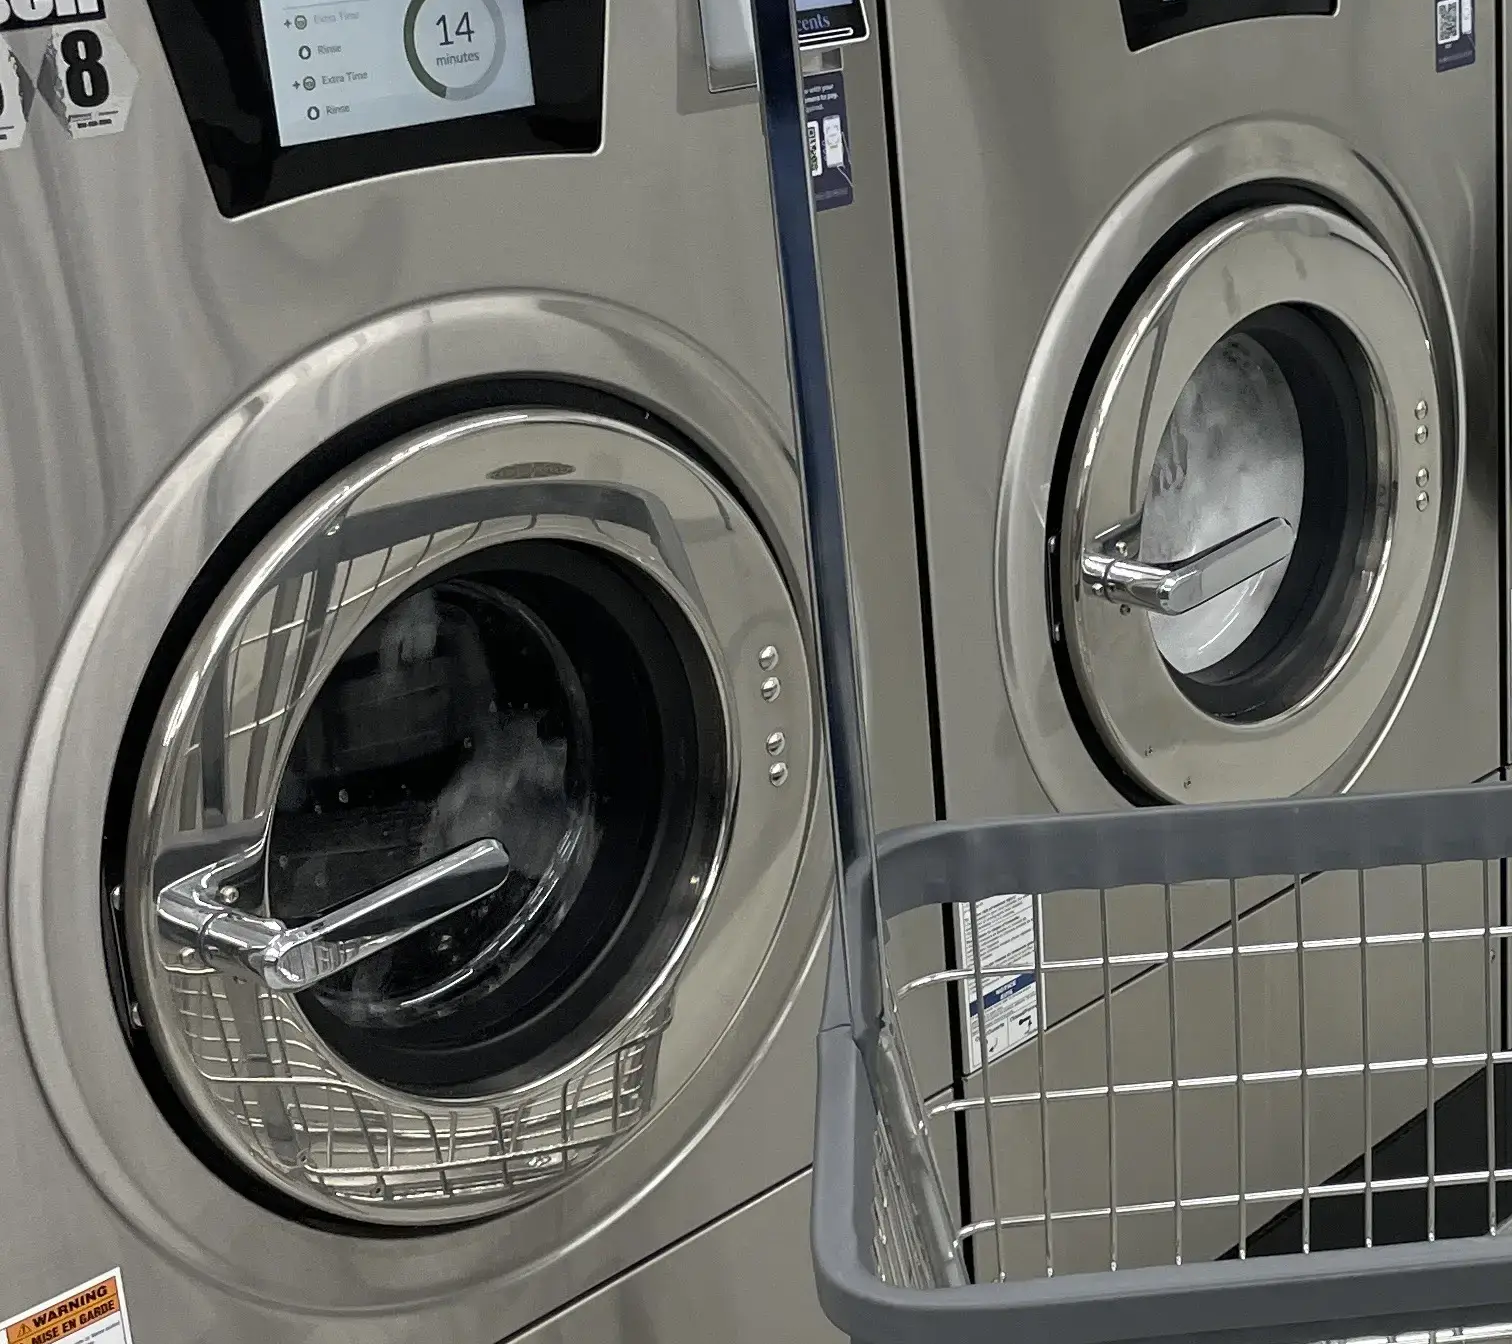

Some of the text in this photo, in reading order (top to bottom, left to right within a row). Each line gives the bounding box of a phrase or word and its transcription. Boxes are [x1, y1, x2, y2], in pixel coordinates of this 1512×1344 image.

[436, 11, 475, 46] 14
[436, 50, 480, 67] minutes
[321, 71, 368, 85] Extra Time
[32, 1285, 108, 1328] WARNING
[62, 1318, 77, 1334] EN
[79, 1299, 115, 1325] GARDE
